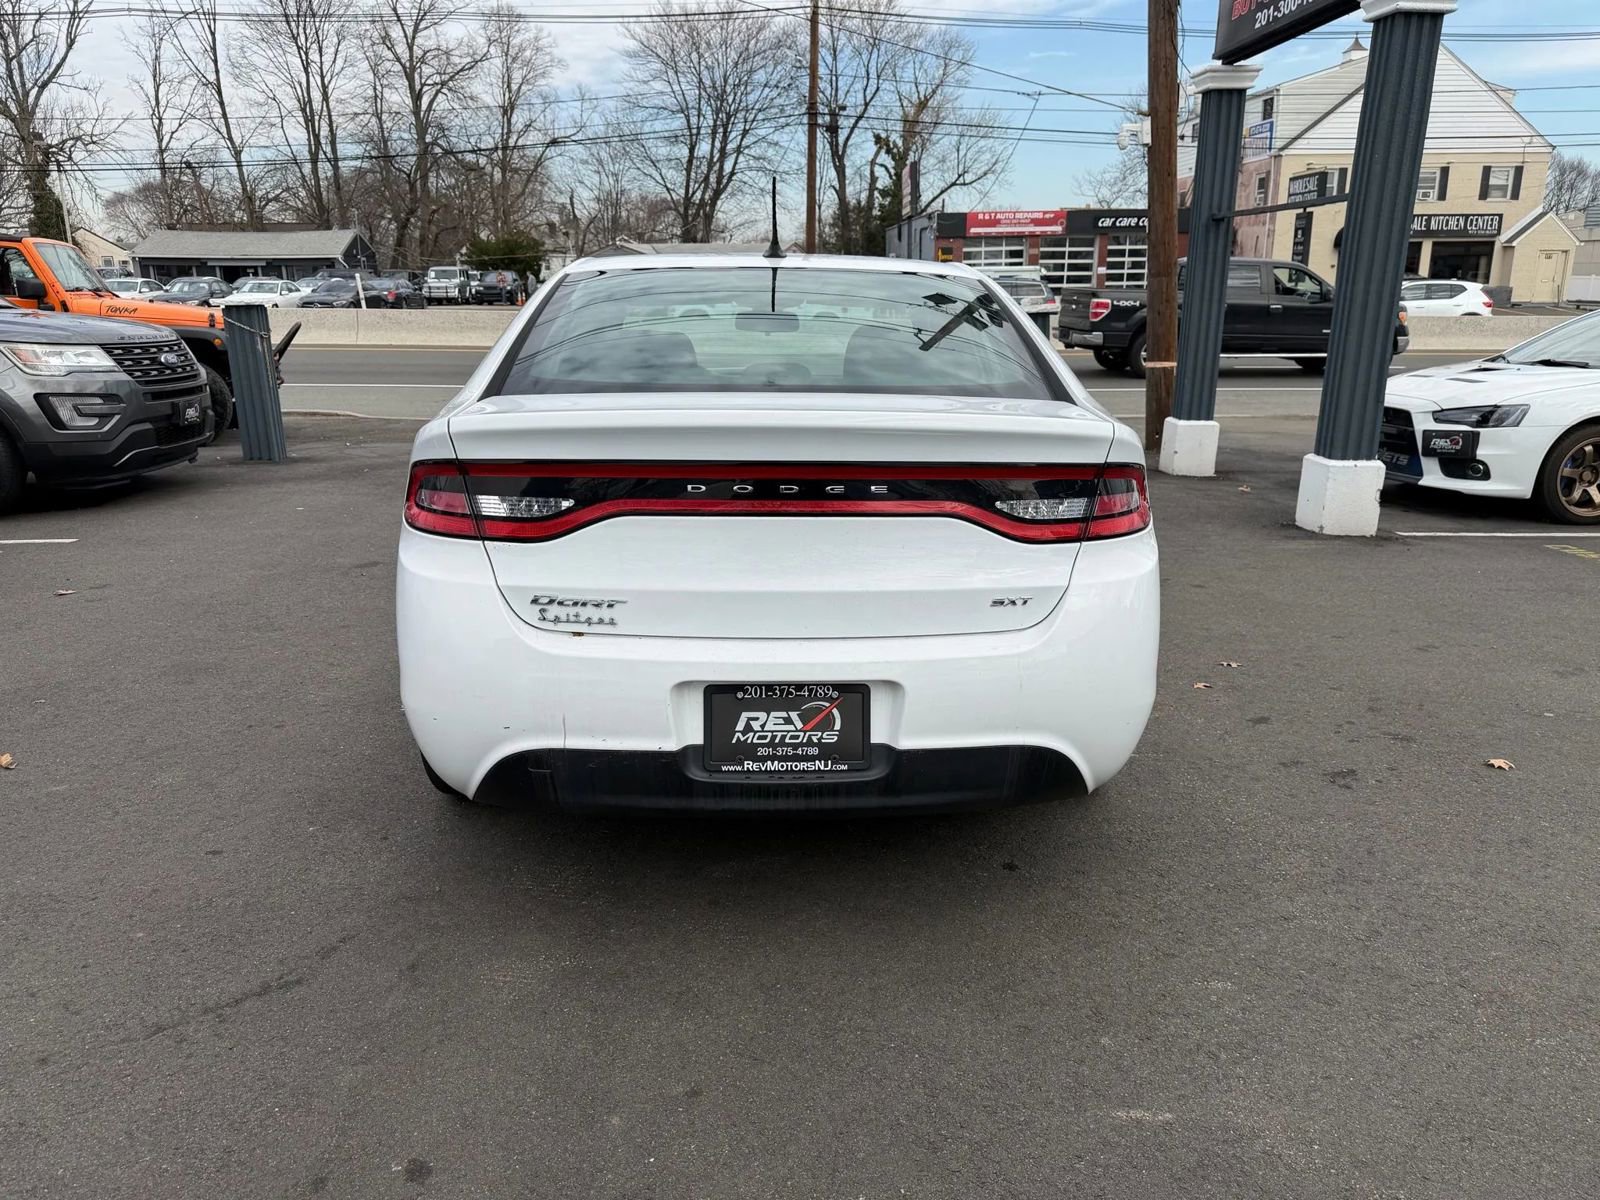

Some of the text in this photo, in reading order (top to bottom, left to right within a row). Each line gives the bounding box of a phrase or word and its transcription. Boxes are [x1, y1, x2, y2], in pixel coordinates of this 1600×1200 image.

[1232, 0, 1269, 20] BU-
[1289, 175, 1319, 195] WHOLESALE
[1098, 217, 1115, 227] car
[1115, 217, 1138, 226] care
[1411, 215, 1499, 231] ALE KITCHEN CENTER
[105, 305, 138, 314] TONKA
[687, 484, 888, 494] DODGE
[990, 597, 1032, 607] SXT
[743, 685, 833, 699] 201-375-4789
[732, 731, 840, 744] MOTORS
[757, 747, 819, 756] 201-375-4789
